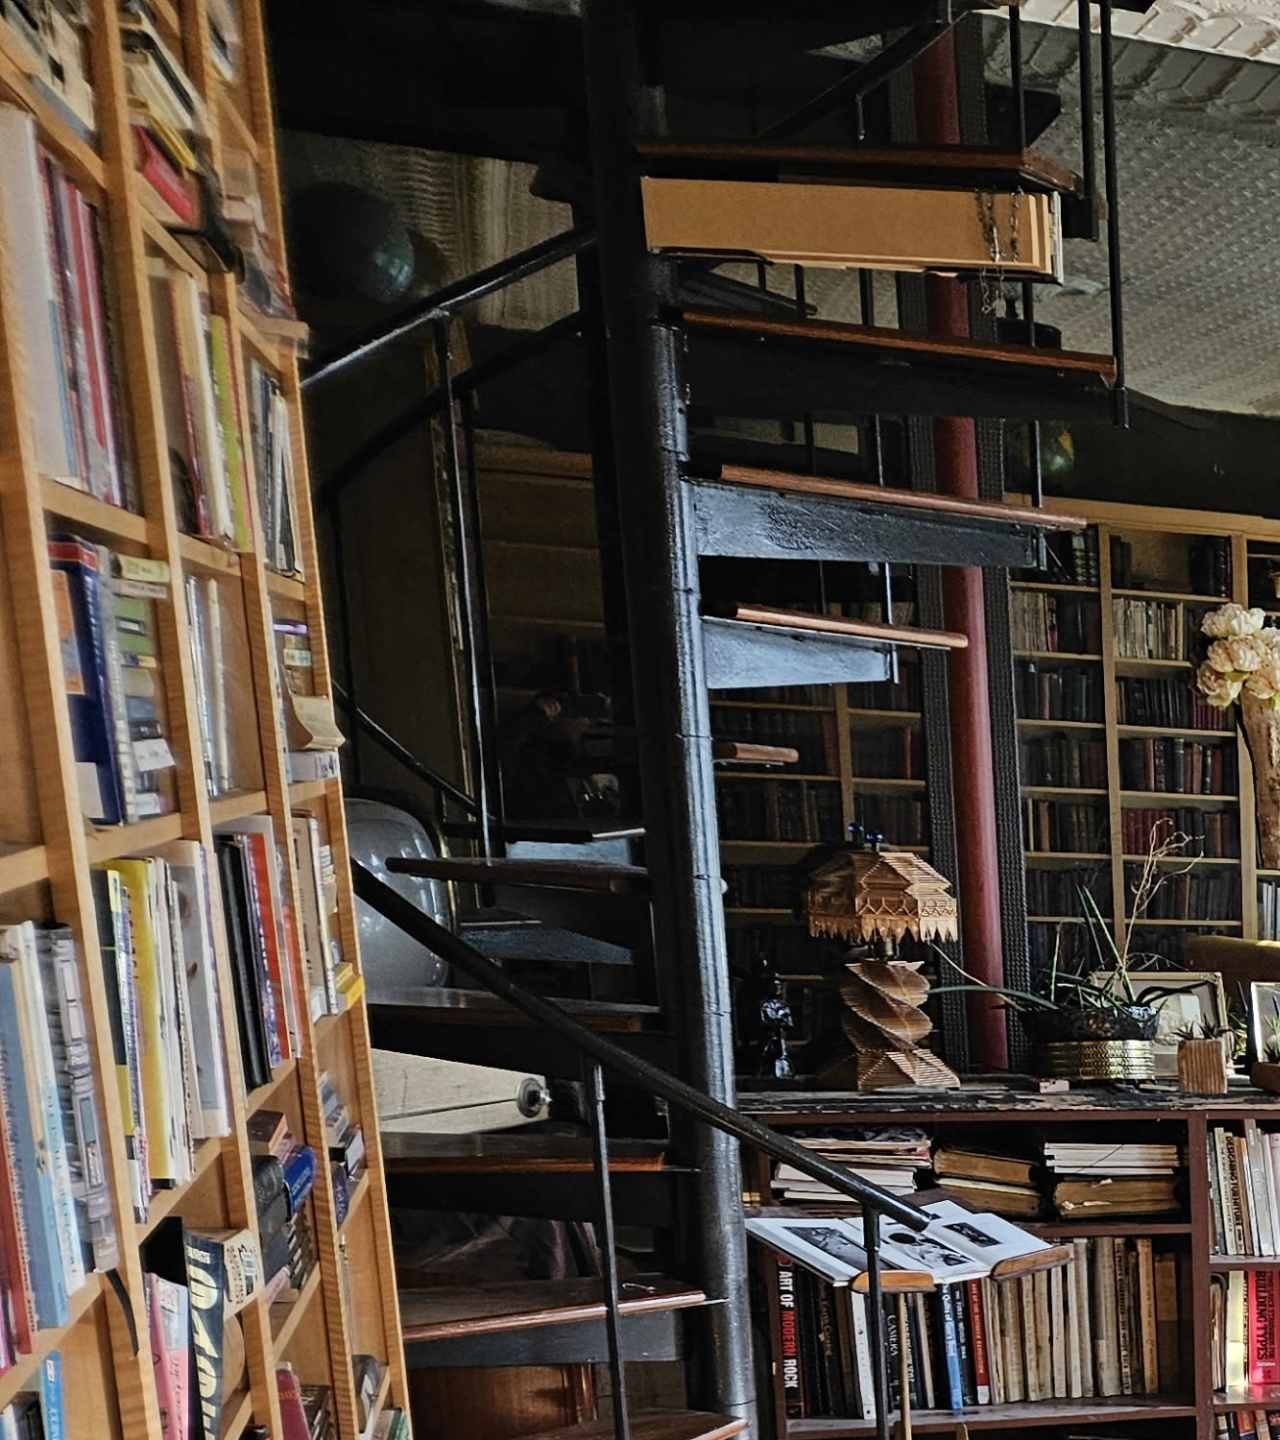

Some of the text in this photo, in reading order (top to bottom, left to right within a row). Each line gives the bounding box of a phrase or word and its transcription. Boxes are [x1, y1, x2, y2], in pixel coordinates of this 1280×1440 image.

[1225, 1135, 1238, 1182] DESIGNING
[1231, 1183, 1243, 1227] FURNITURE
[779, 1271, 799, 1389] ART OF MODERN ROCK
[886, 1314, 899, 1357] CAMERA
[1256, 1271, 1268, 1361] BUILDING TYPES
